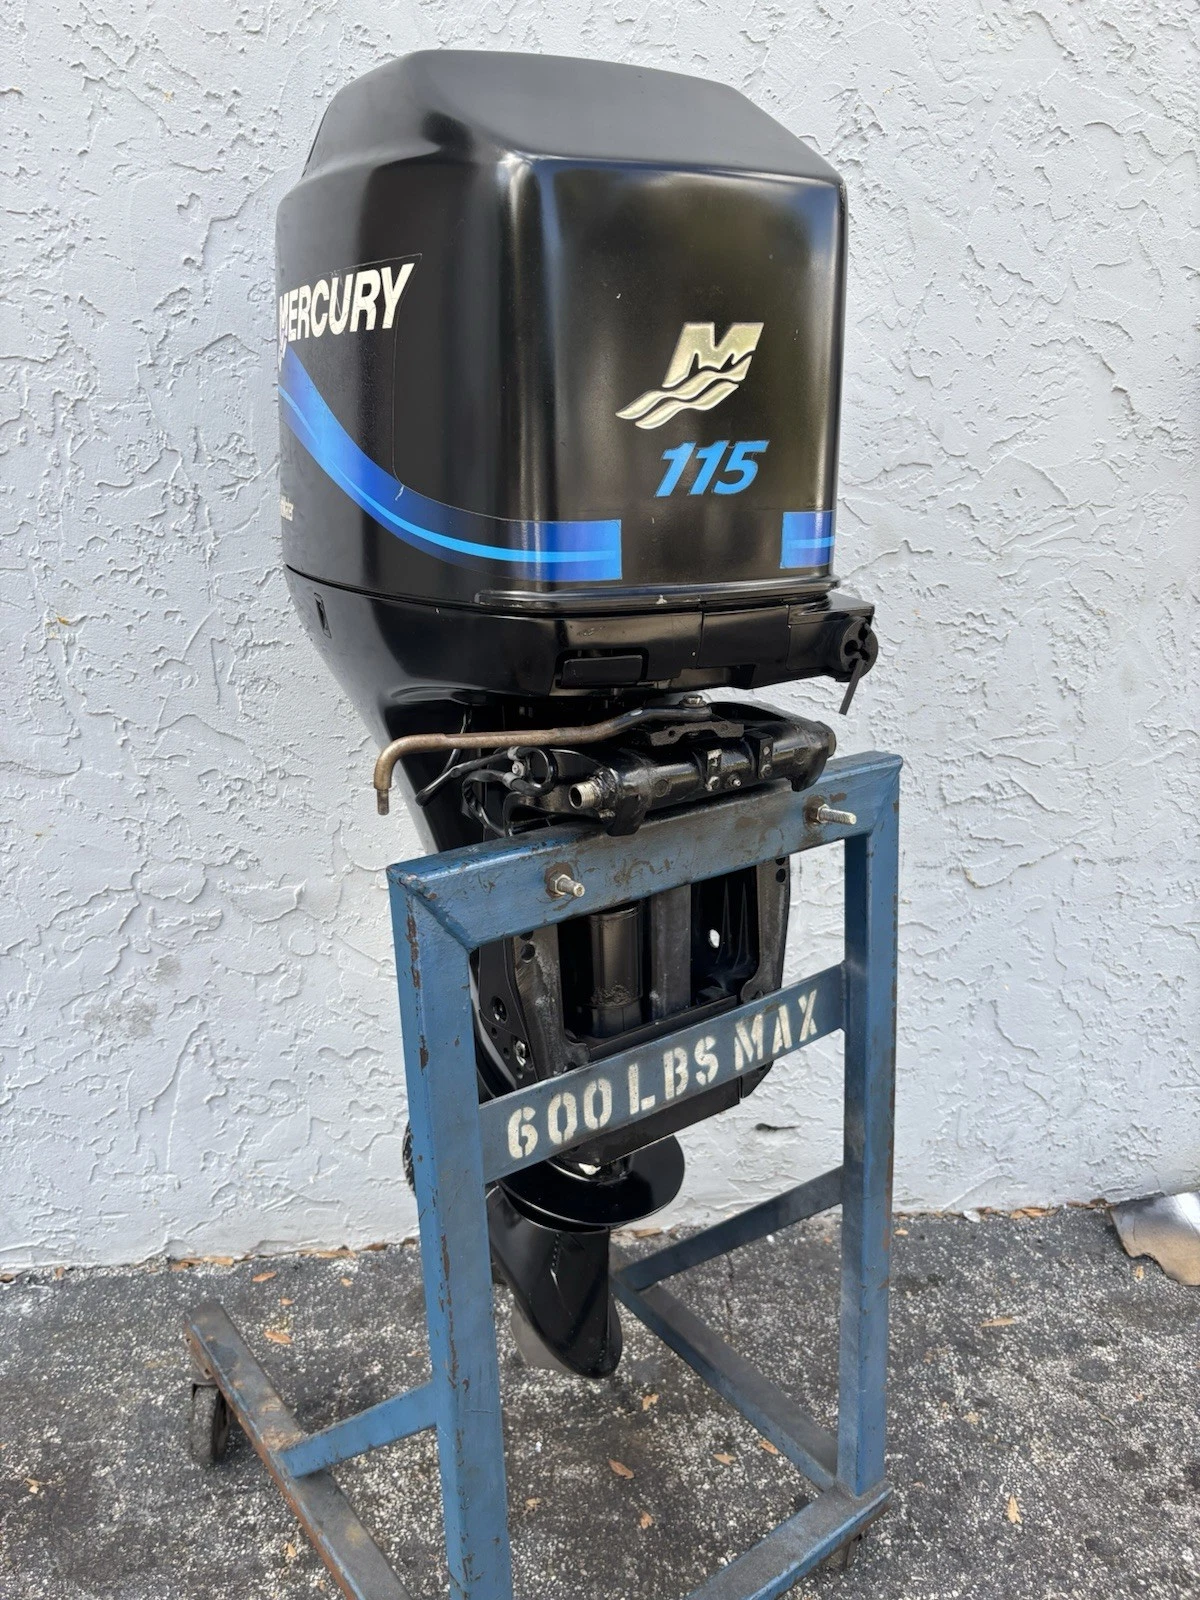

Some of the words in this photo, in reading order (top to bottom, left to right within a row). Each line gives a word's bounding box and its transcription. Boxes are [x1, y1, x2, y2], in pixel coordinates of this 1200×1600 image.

[278, 262, 415, 343] MERCURY
[655, 439, 770, 498] 115
[507, 1078, 612, 1159] 600
[628, 1035, 719, 1115] LBS
[734, 989, 818, 1071] MAX
